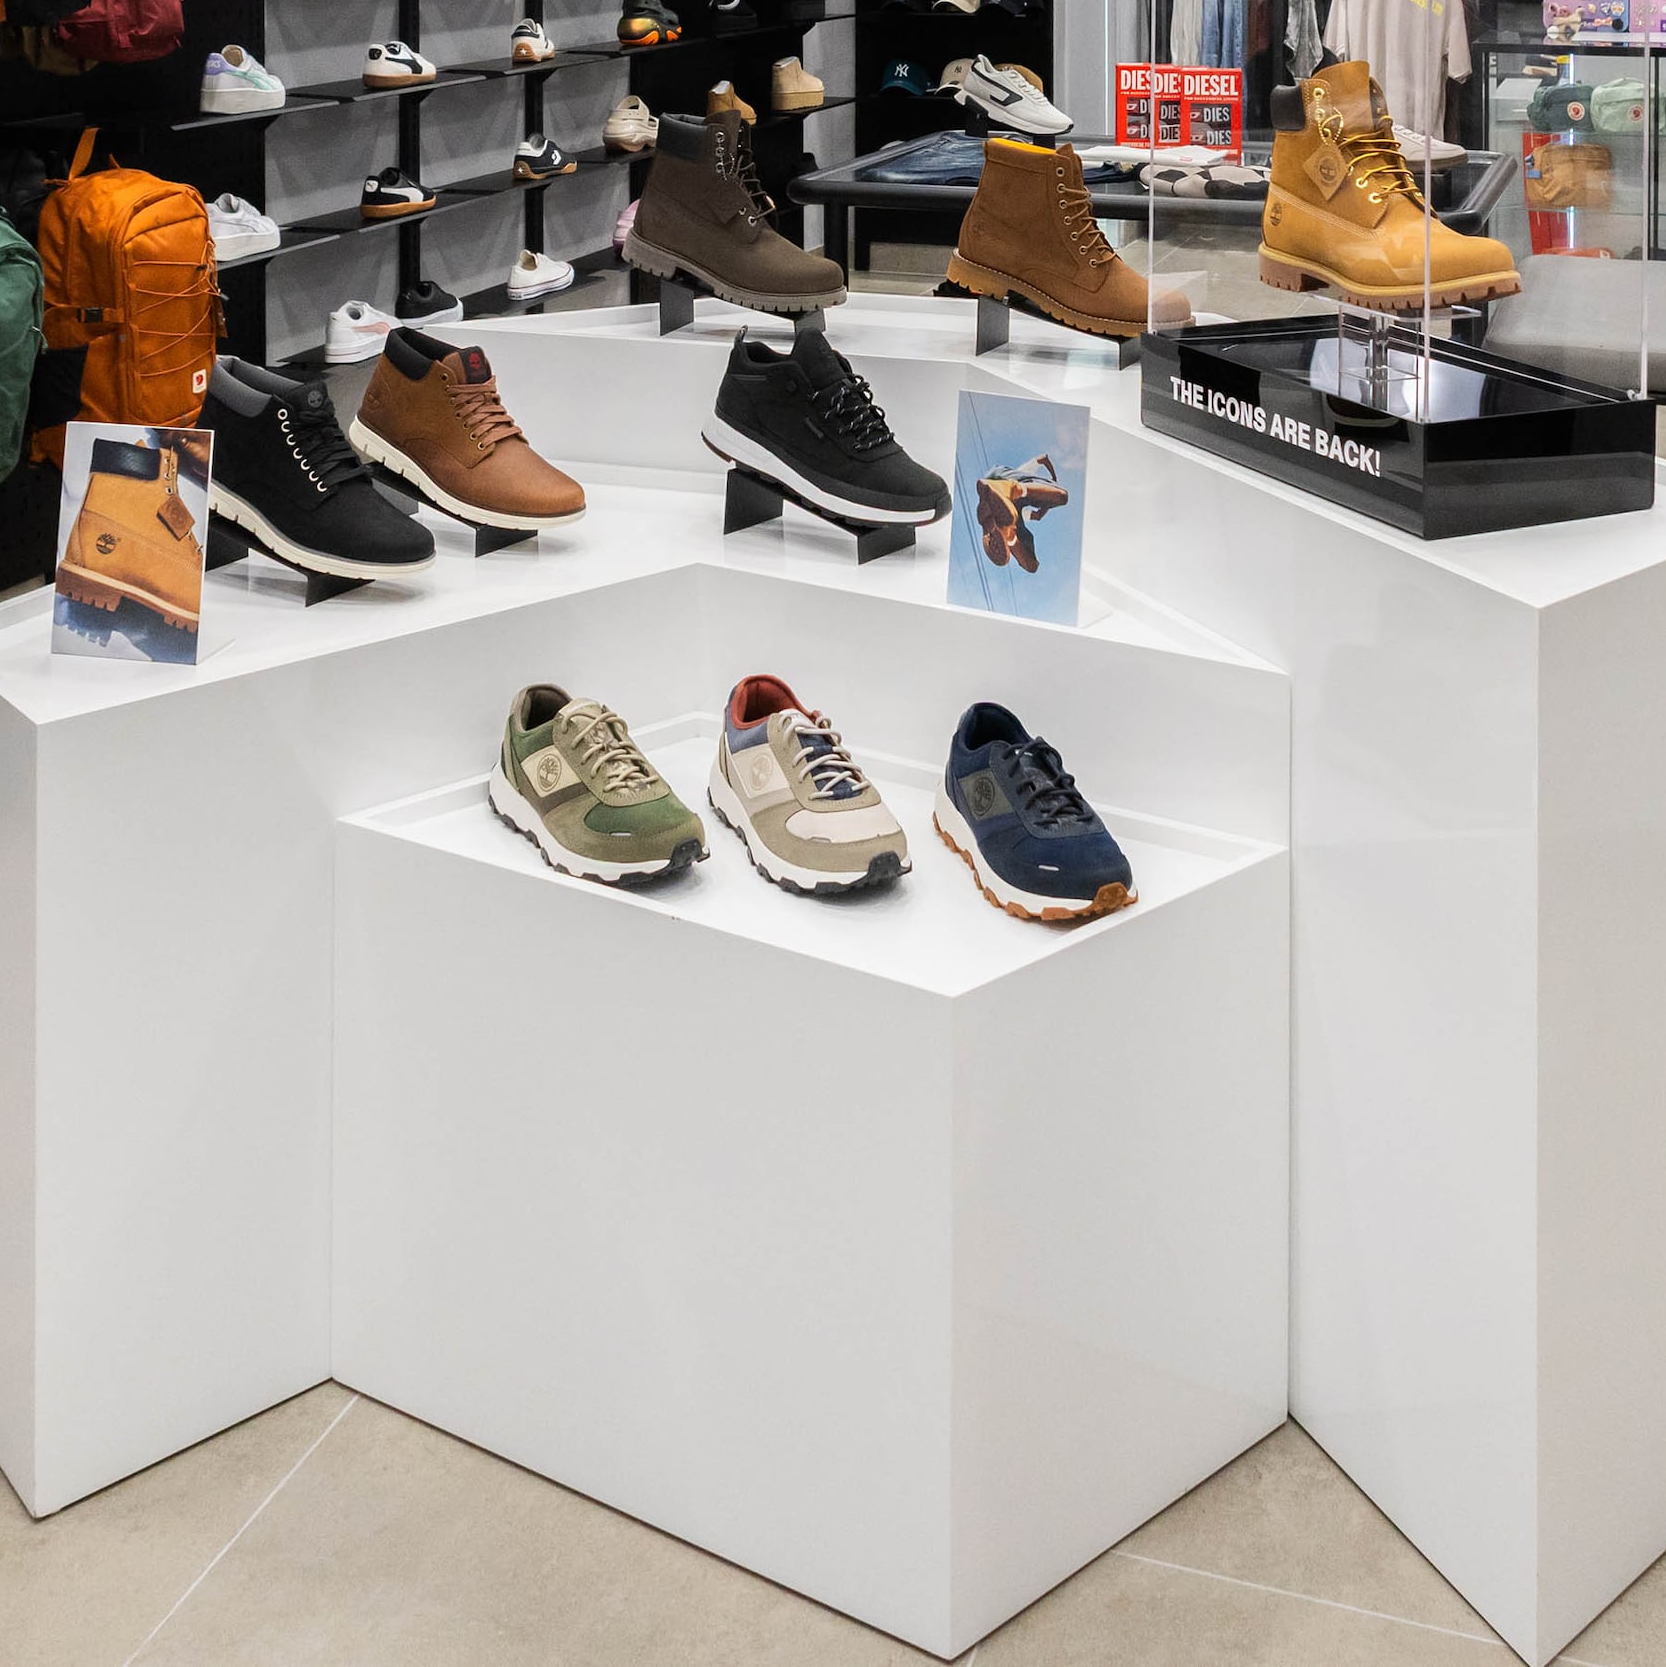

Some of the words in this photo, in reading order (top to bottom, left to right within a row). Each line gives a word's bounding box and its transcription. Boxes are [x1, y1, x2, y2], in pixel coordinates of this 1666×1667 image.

[1155, 73, 1181, 93] DIE
[1185, 75, 1238, 96] DIESEL
[1204, 107, 1229, 122] DIES
[1171, 376, 1204, 409] THE
[1208, 389, 1266, 432] ICONS
[1270, 413, 1311, 450] ARE
[1315, 429, 1380, 477] BACK!
